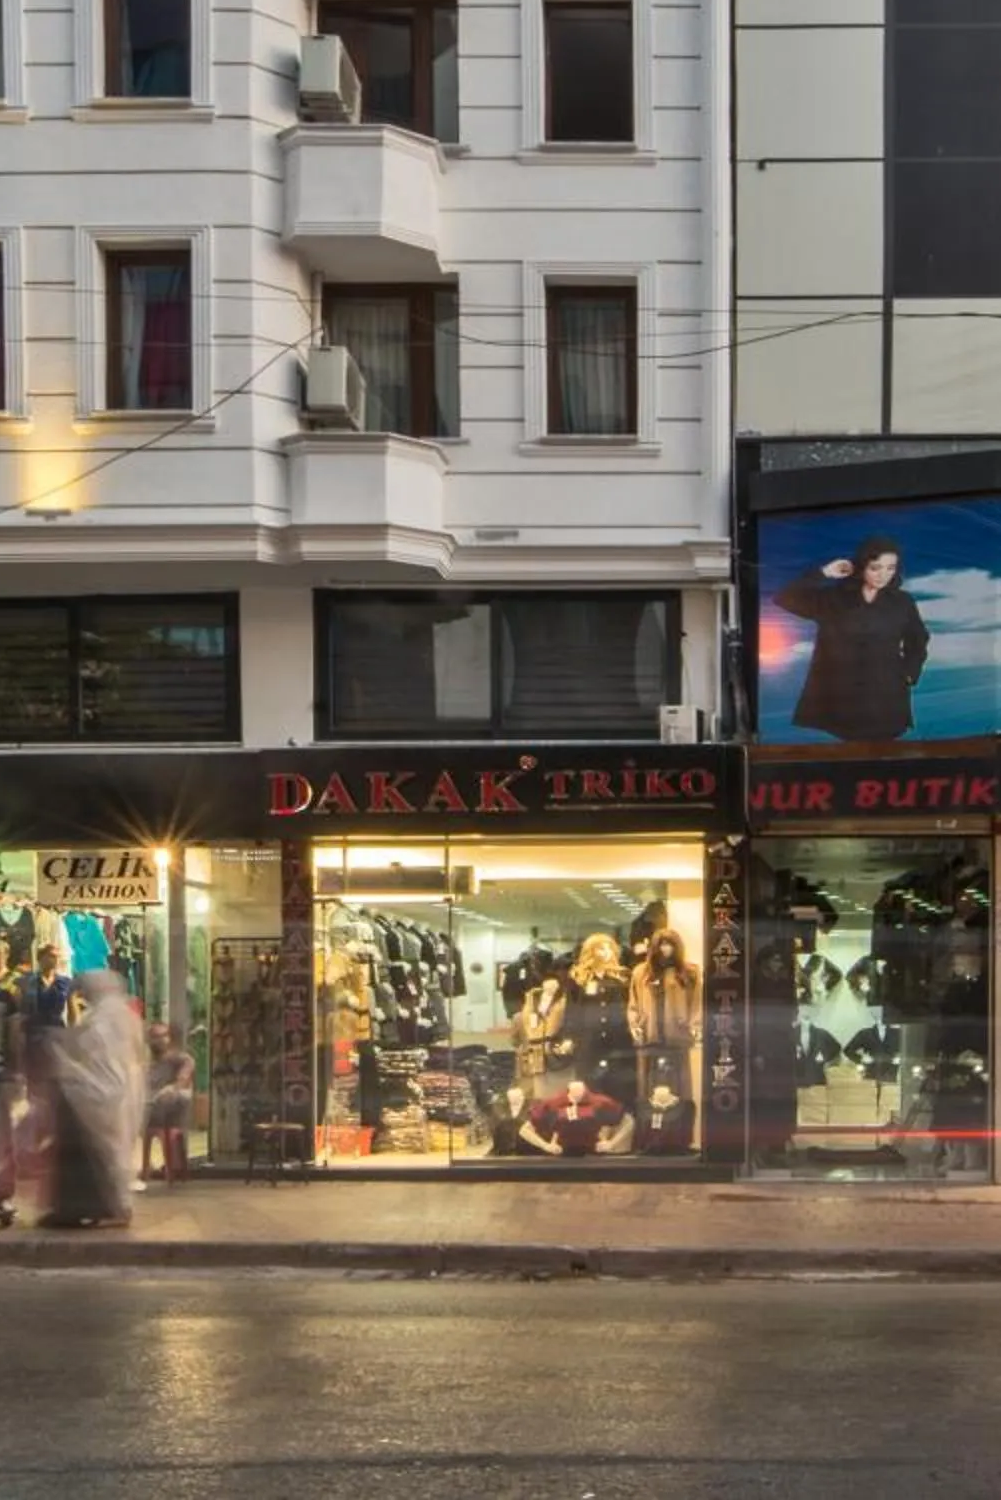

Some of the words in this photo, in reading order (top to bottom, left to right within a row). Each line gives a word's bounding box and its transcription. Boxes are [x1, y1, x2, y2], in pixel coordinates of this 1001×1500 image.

[266, 770, 528, 814] DAKAK
[544, 758, 716, 799] TRİKO
[61, 883, 149, 899] FASHION
[712, 858, 742, 979] DAKAK
